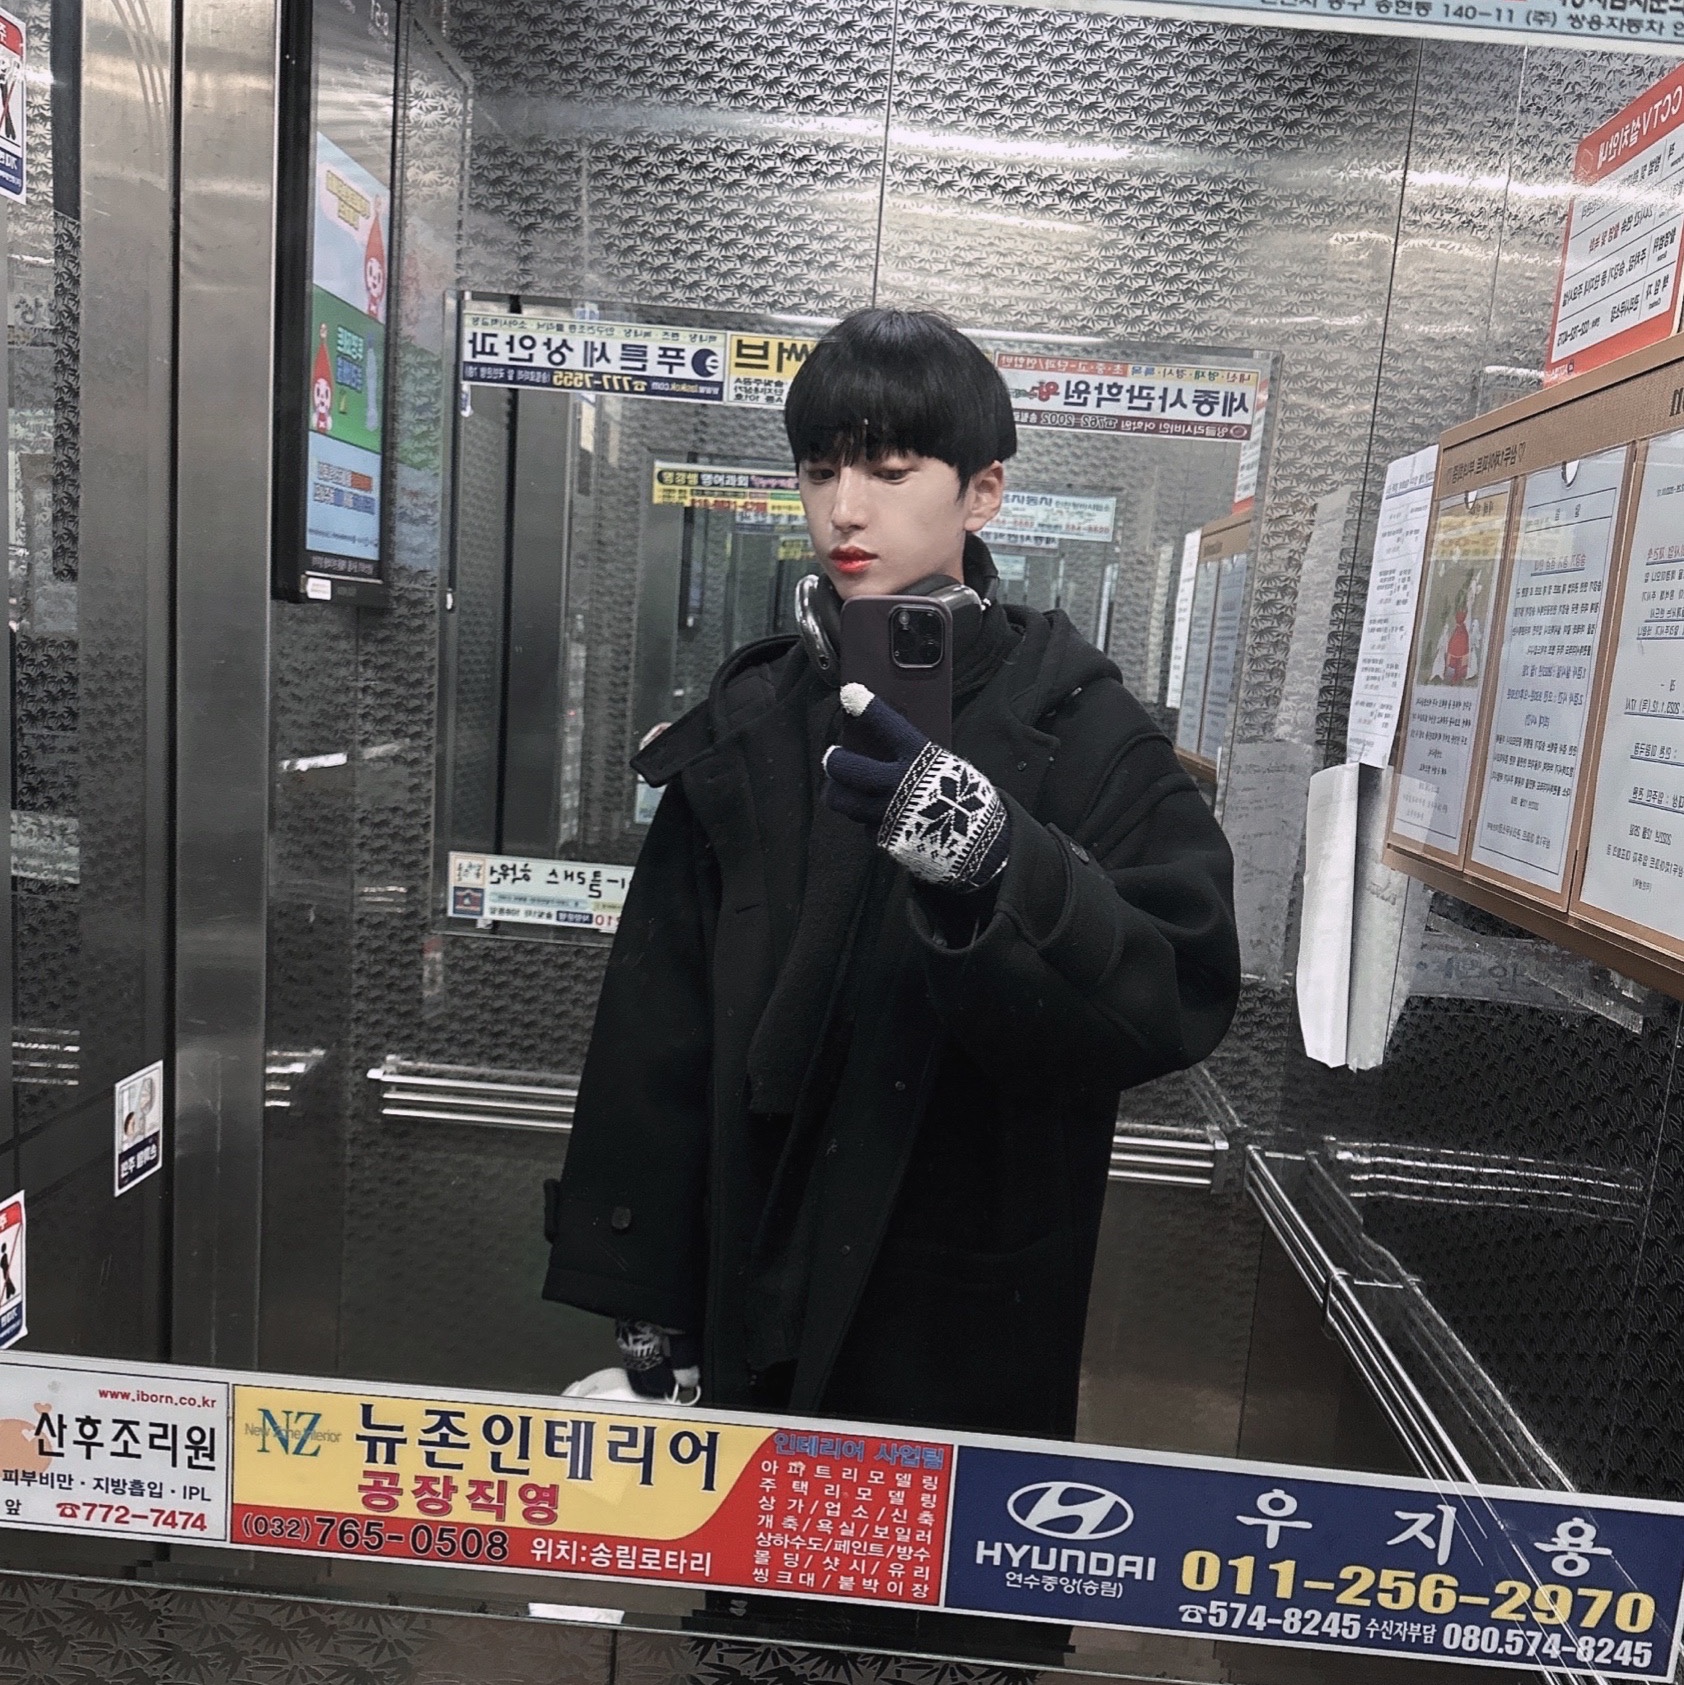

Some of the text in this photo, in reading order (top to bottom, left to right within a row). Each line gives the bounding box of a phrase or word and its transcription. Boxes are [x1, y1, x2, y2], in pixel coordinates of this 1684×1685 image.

[1444, 4, 1514, 24] 140-11
[1526, 9, 1557, 27] (주)
[1567, 12, 1666, 36] 쌍용자동차
[98, 1388, 217, 1409] www.iborn.co.kr
[34, 1411, 217, 1472] 산후조리원
[257, 1409, 323, 1458] NZ
[355, 1403, 721, 1493] 뉴존인테리어
[773, 1432, 945, 1471] 인테리어 사업팀
[2, 1470, 212, 1503] 피부비만 지방흡입 IPL
[357, 1469, 561, 1528] 공장직영
[6, 1499, 208, 1532] 앞 772-7474
[531, 1534, 712, 1578] 위치:송림로타리
[755, 1530, 932, 1563] 상하수도/페인트/방수
[976, 1540, 1157, 1583] HYUNDAI
[1005, 1571, 1125, 1601] 연수중앙(송림)
[1180, 1549, 1657, 1636] 011-256-2970
[1208, 1600, 1656, 1671] 574-8245 수신자부담 080.574-8245
